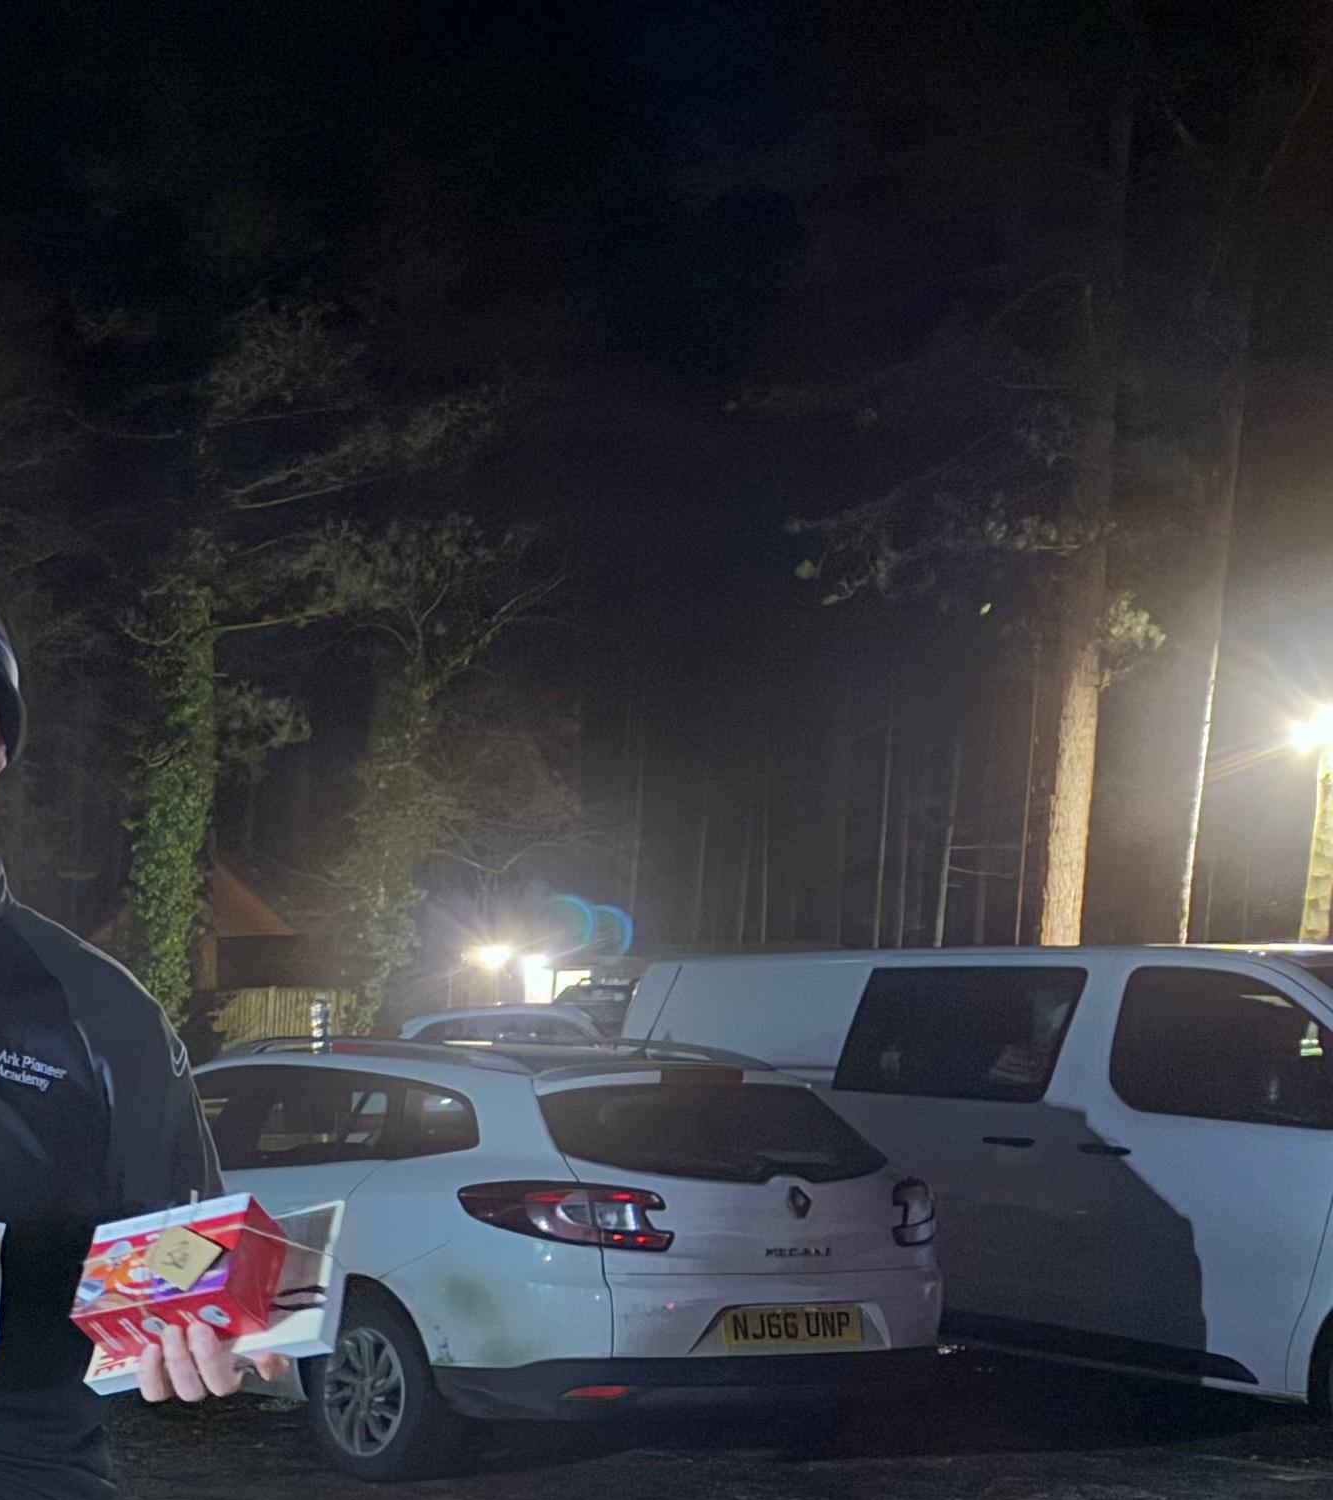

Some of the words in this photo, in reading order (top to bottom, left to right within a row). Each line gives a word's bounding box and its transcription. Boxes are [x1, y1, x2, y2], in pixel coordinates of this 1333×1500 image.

[22, 1055, 67, 1079] Pioneer
[733, 1312, 799, 1341] NJ66
[805, 1311, 850, 1337] UNP
